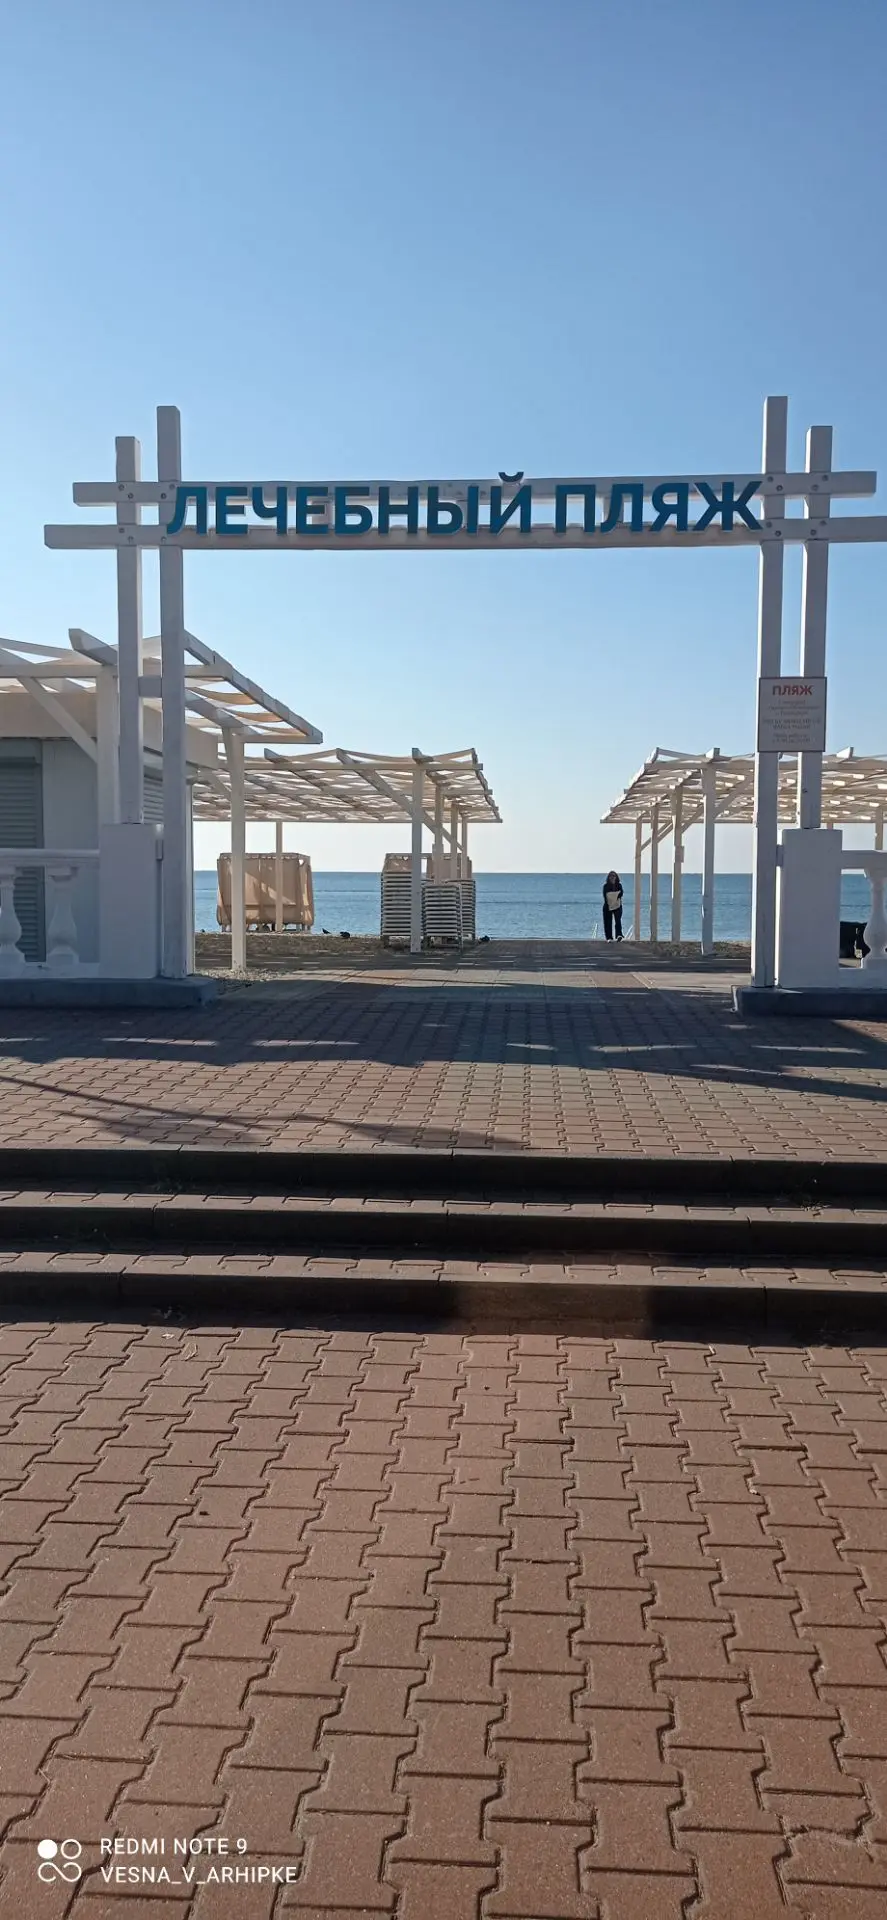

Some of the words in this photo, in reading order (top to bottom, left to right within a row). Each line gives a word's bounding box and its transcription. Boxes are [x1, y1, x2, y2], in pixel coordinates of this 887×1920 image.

[165, 471, 532, 536] ЛЕЧЕБНЫЙ
[554, 479, 765, 535] ПЛЯЖ
[772, 685, 813, 696] ПЛЯЖ
